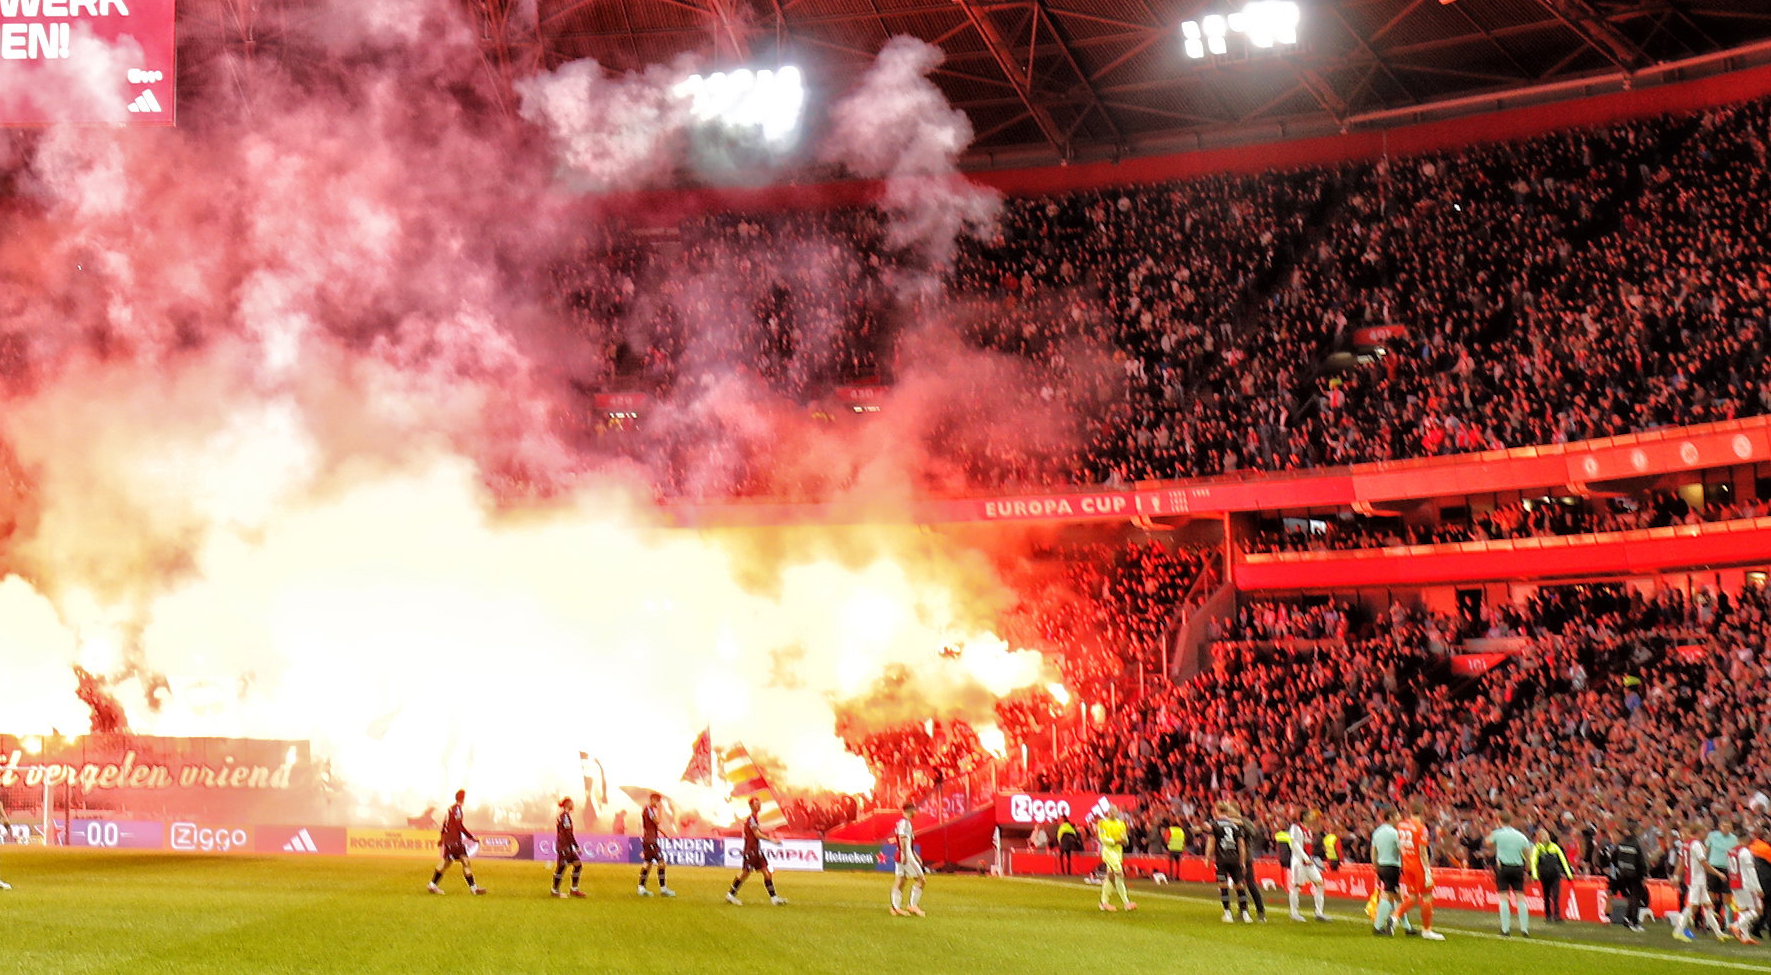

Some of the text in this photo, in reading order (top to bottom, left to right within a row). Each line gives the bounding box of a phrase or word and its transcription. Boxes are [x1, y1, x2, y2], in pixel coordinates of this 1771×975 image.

[985, 496, 1073, 518] EUROPA
[1081, 494, 1127, 514] CUP
[178, 746, 298, 790] vriend
[1011, 794, 1071, 824] Ziggo
[170, 822, 247, 851] Ziggo
[824, 851, 874, 864] Heineken
